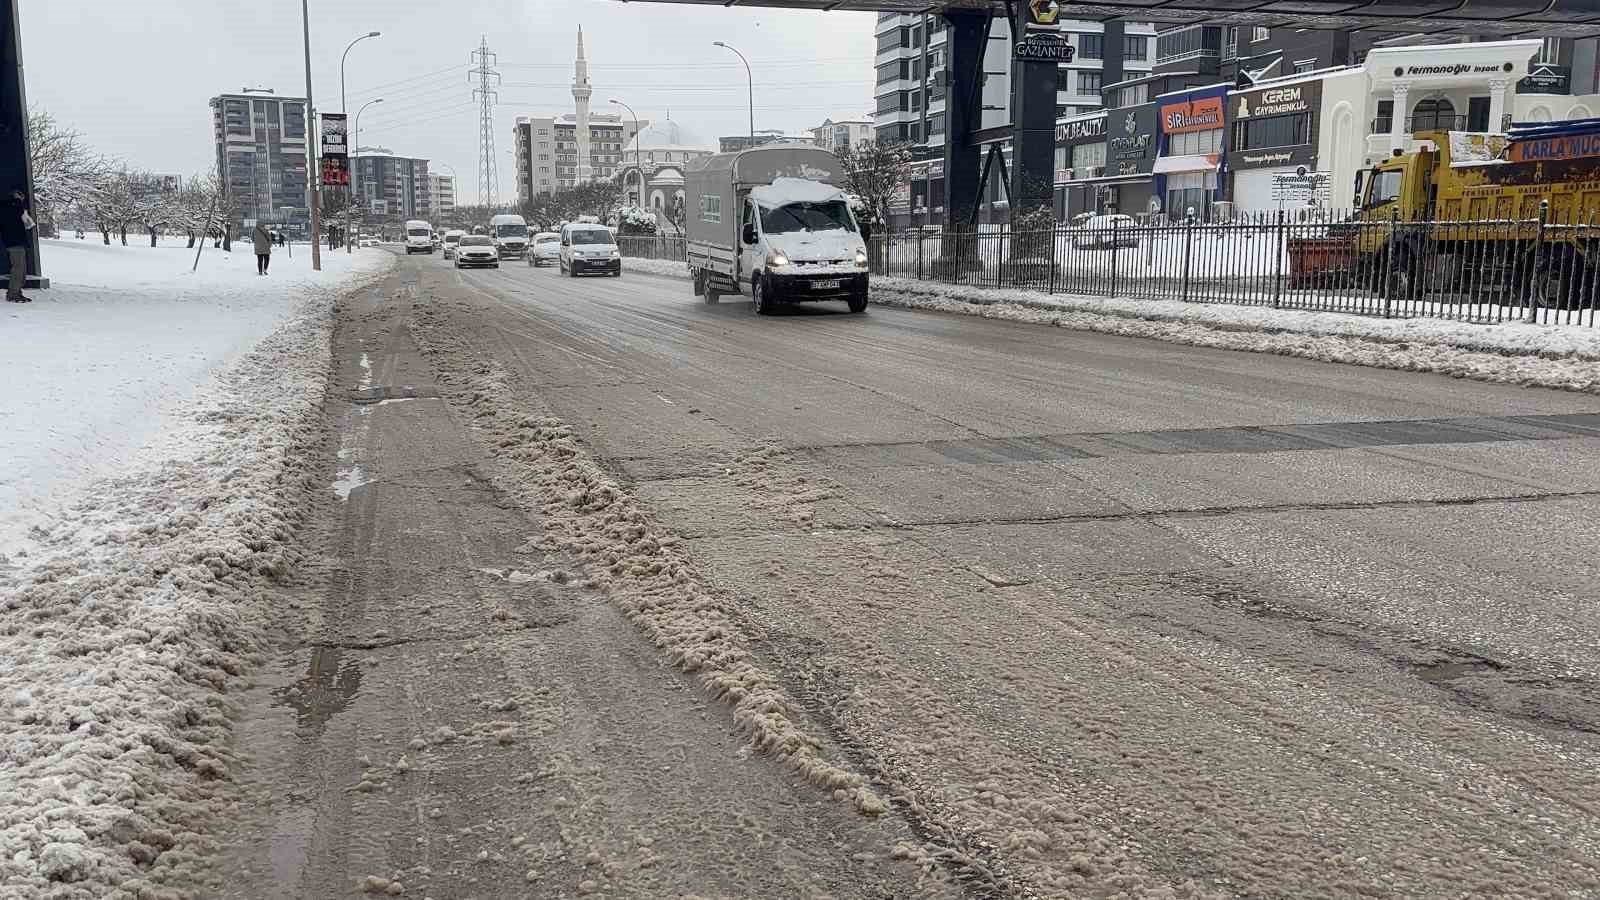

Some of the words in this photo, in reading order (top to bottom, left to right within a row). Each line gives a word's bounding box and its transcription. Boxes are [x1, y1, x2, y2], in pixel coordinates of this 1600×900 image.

[1262, 88, 1301, 104] KEREM
[1071, 118, 1103, 139] BEAUTY
[1522, 140, 1564, 159] KARLA
